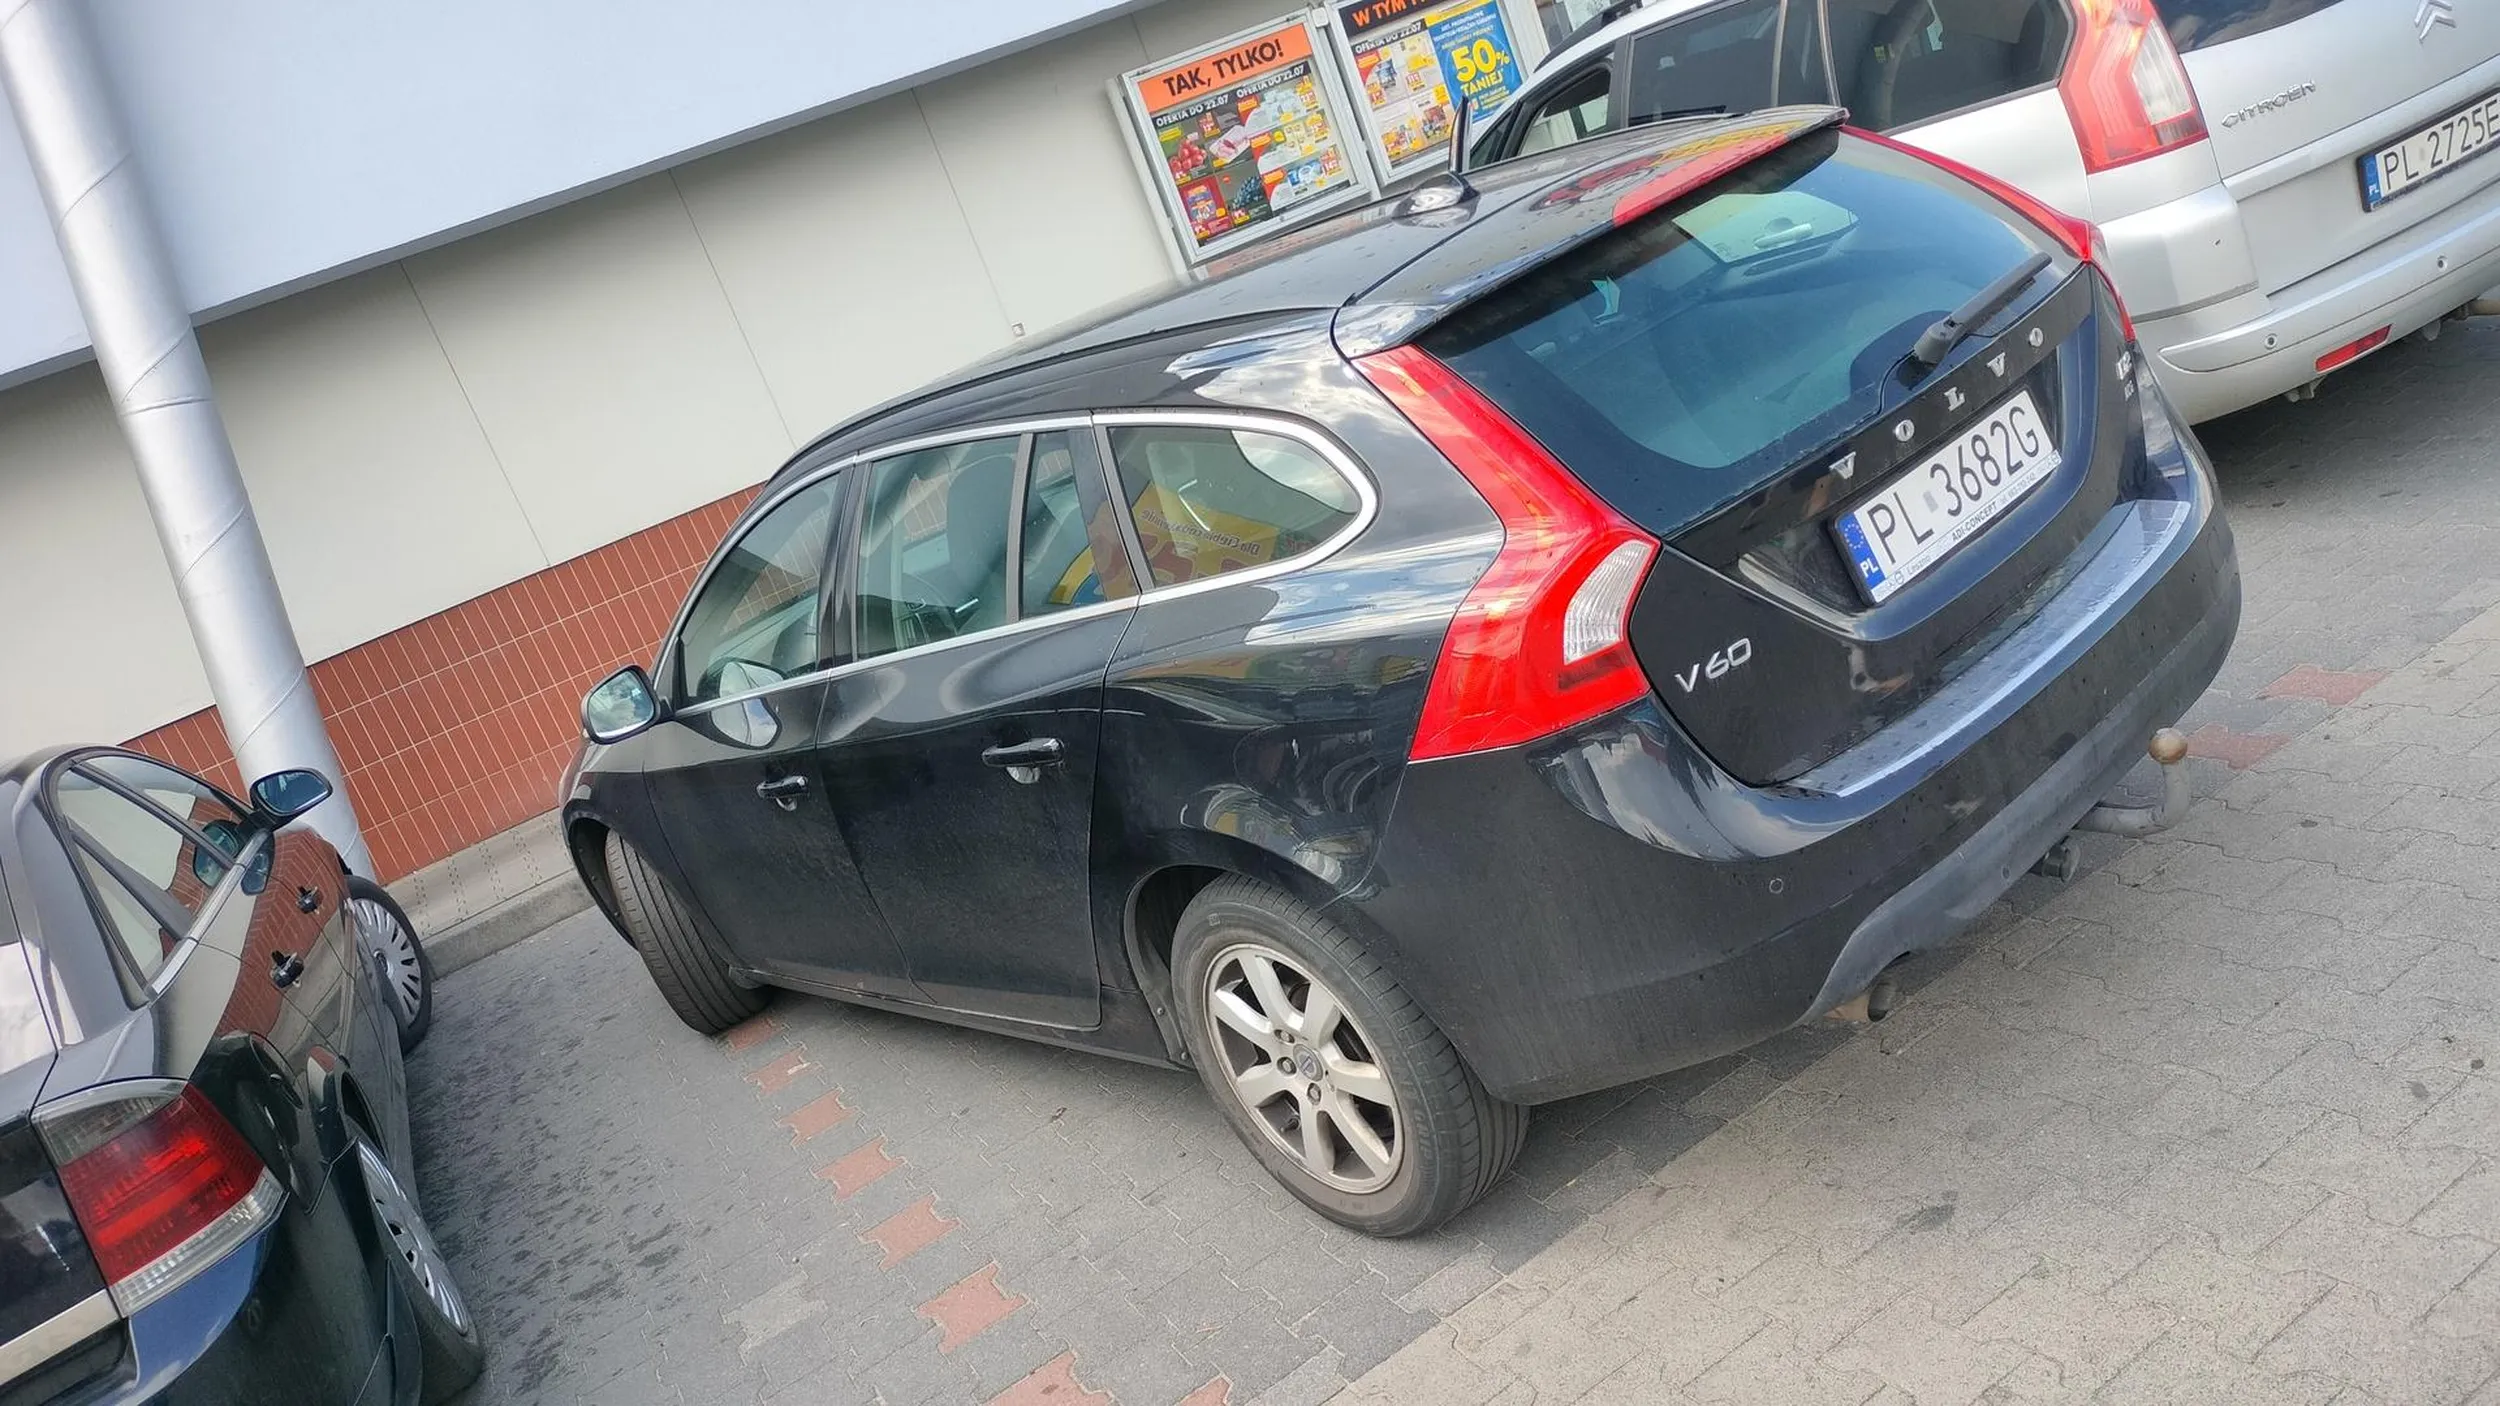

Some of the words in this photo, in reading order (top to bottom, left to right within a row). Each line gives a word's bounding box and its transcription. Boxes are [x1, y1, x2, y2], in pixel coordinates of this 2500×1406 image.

[1352, 12, 1370, 27] W
[1399, 21, 1422, 38] 22.07
[1163, 67, 1212, 97] TAK,
[1212, 38, 1285, 80] TYLKO!
[1452, 38, 1511, 83] 50%
[1236, 82, 1269, 99] OFERTA
[1269, 75, 1283, 89] DO
[1283, 63, 1306, 82] 22.07
[1461, 69, 1505, 96] TANIEJ
[1156, 109, 1189, 128] OFERTA
[1189, 103, 1205, 117] DO
[1206, 93, 1230, 111] 22.07
[2383, 145, 2420, 191] PL
[2427, 98, 2500, 169] 2725E
[1828, 326, 2044, 480] VOLVO
[1866, 491, 1934, 565] PL
[1929, 405, 2040, 518] 3682G
[1950, 501, 1999, 542] ADI-CONCEPT
[1859, 558, 1879, 578] PL
